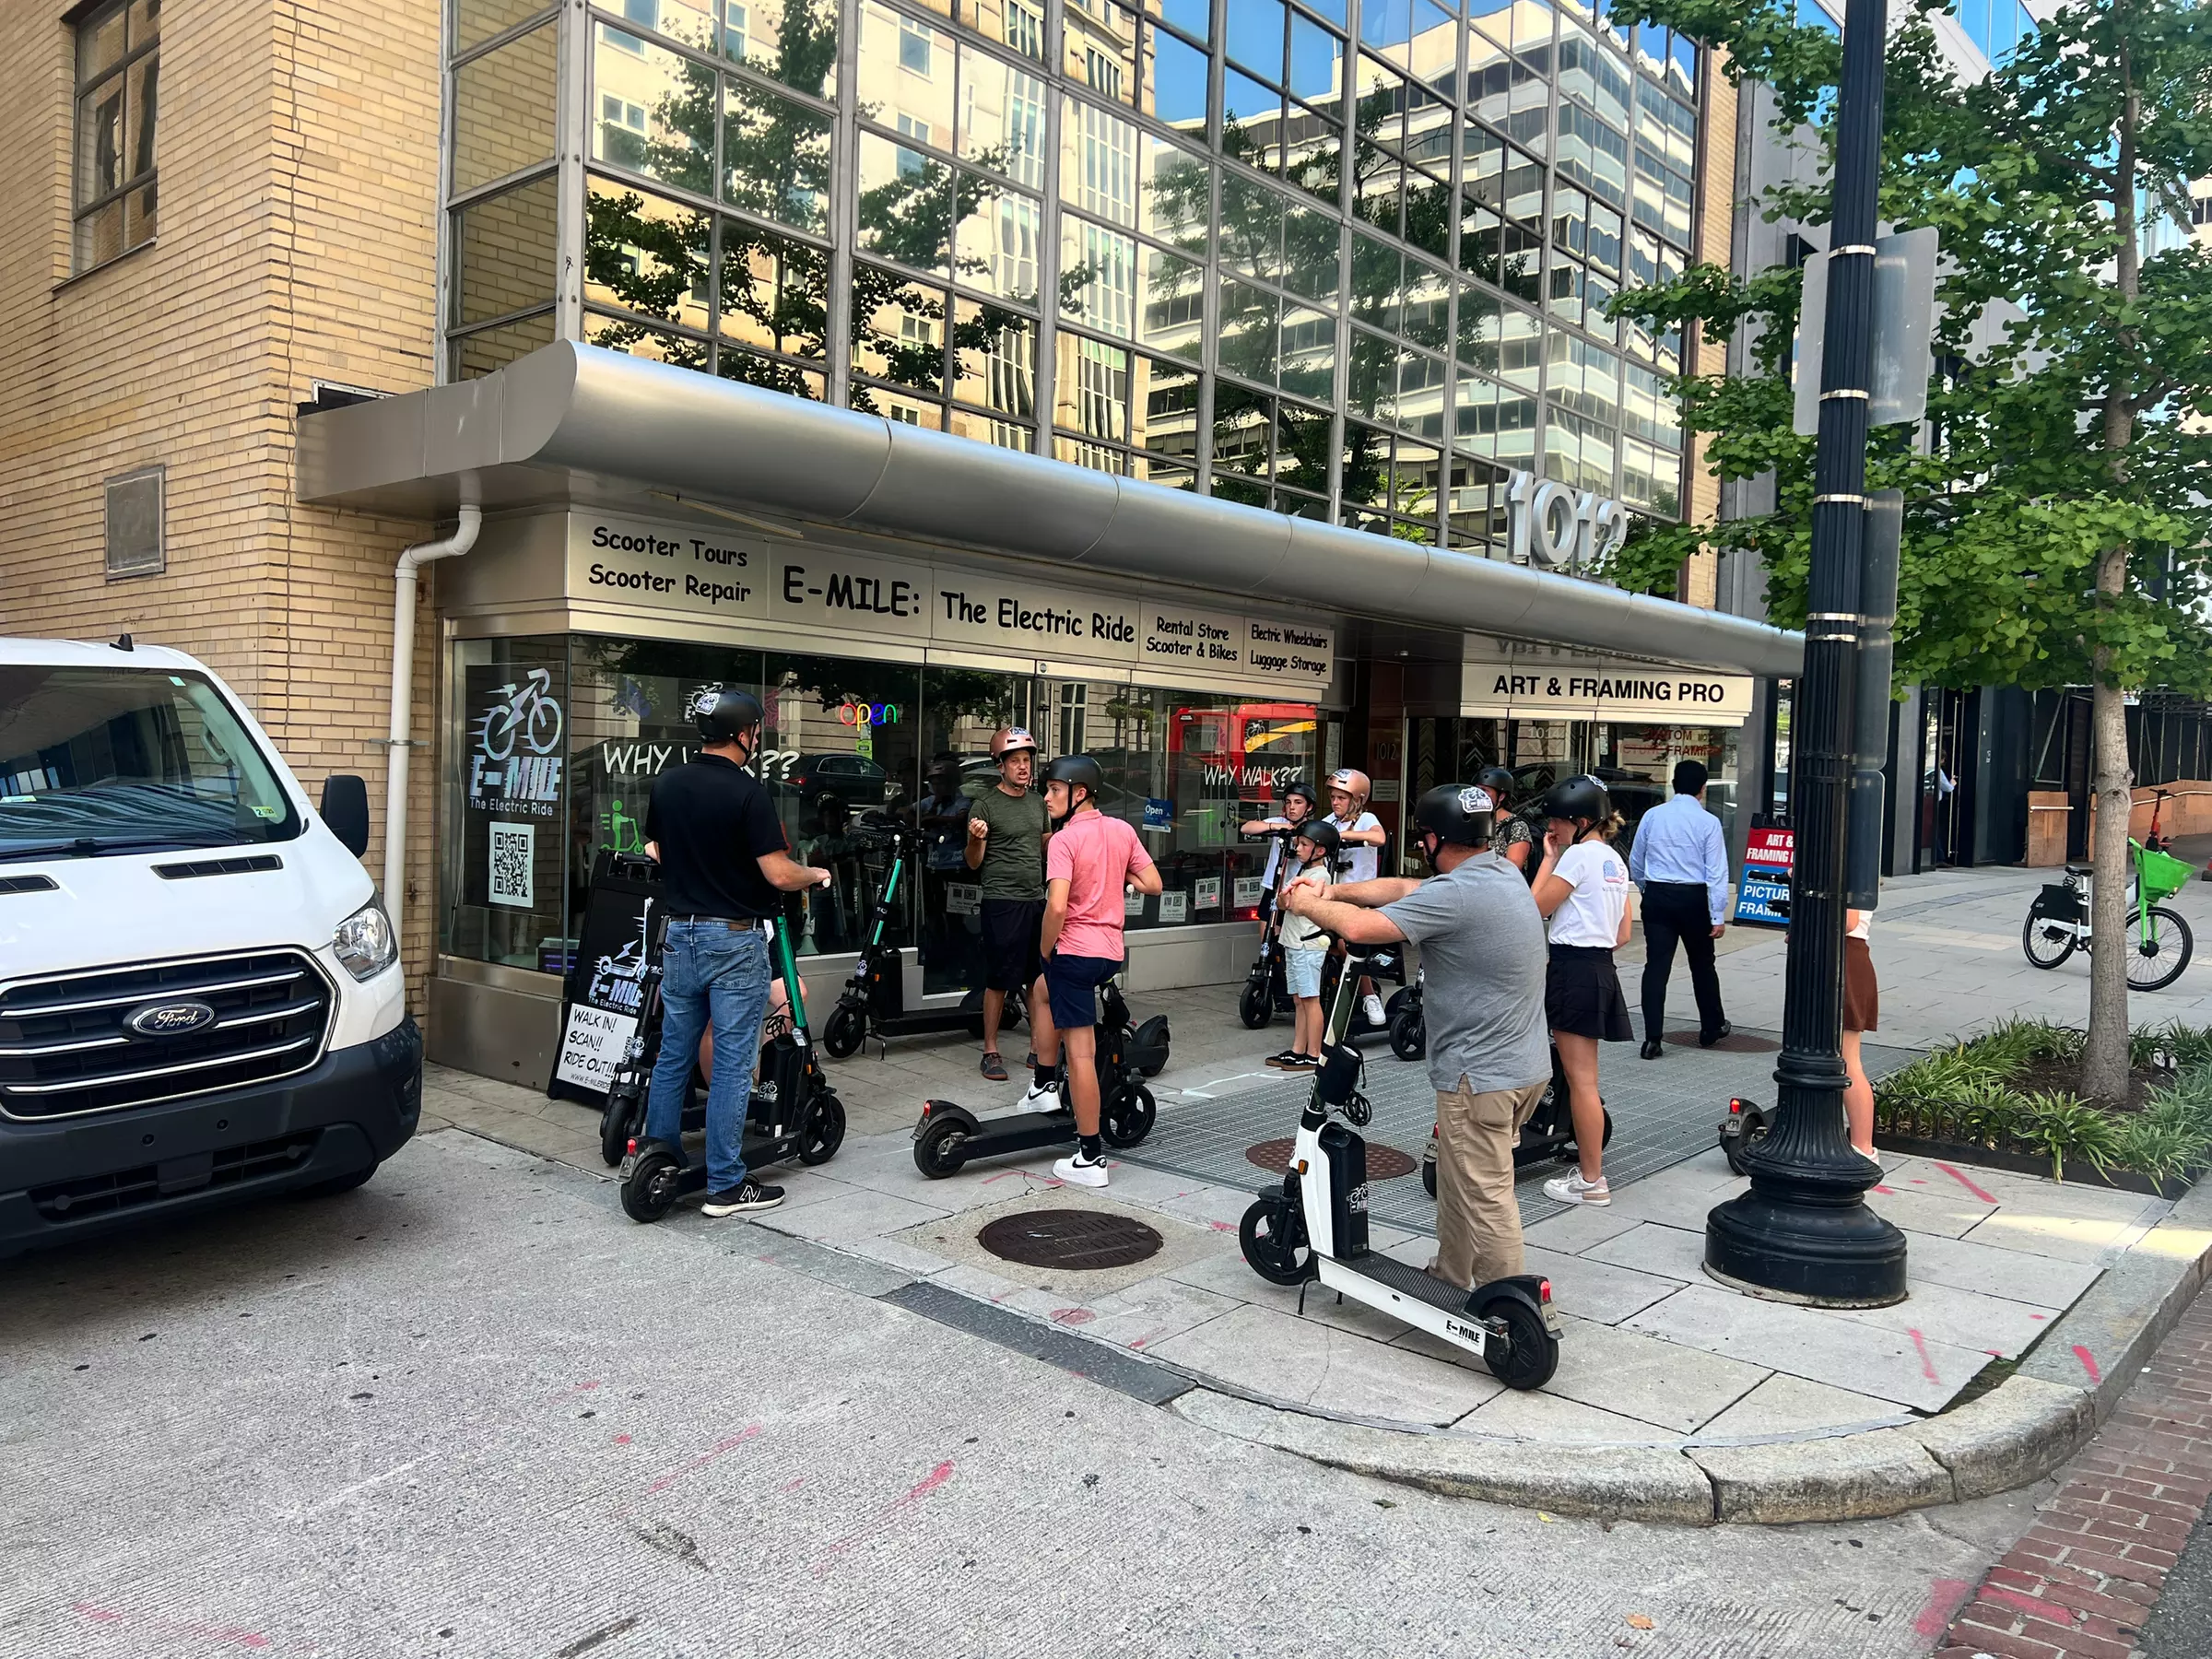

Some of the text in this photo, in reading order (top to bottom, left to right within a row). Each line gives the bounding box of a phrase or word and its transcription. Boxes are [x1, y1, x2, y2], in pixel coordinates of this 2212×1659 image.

[1503, 468, 1628, 575] 1012
[591, 525, 748, 568] Scooter Tours
[588, 563, 751, 605] Scooter Repair
[782, 565, 1135, 644] E-MILE: The Electric Ride
[1156, 617, 1230, 641] Rental Store
[1251, 623, 1328, 650] Electric Wheelchairs
[1146, 636, 1238, 663] Scooter & Bikes
[1250, 649, 1327, 675] Luggage Storage
[1492, 675, 1724, 703] ART & FRAMING PRO
[840, 703, 897, 732] open
[603, 743, 673, 775] WHY
[1376, 742, 1397, 760] 1012
[469, 755, 562, 801] E-MILE
[1204, 764, 1302, 788] WHY WALK??
[470, 796, 553, 817] The Electric Ride
[1145, 805, 1163, 816] Open
[1766, 833, 1784, 846] ART
[1747, 848, 1790, 863] FRAMING
[1744, 886, 1790, 900] PICTUR
[588, 973, 643, 1007] E-MILE
[154, 1007, 198, 1030] Ford
[599, 998, 623, 1011] Electric
[623, 1005, 637, 1015] Ride
[574, 1008, 618, 1033] WALK IN!
[569, 1030, 604, 1052] SCAN!!
[563, 1051, 615, 1078] RIDE OUT!!!
[1446, 1319, 1480, 1344] E-MILE
